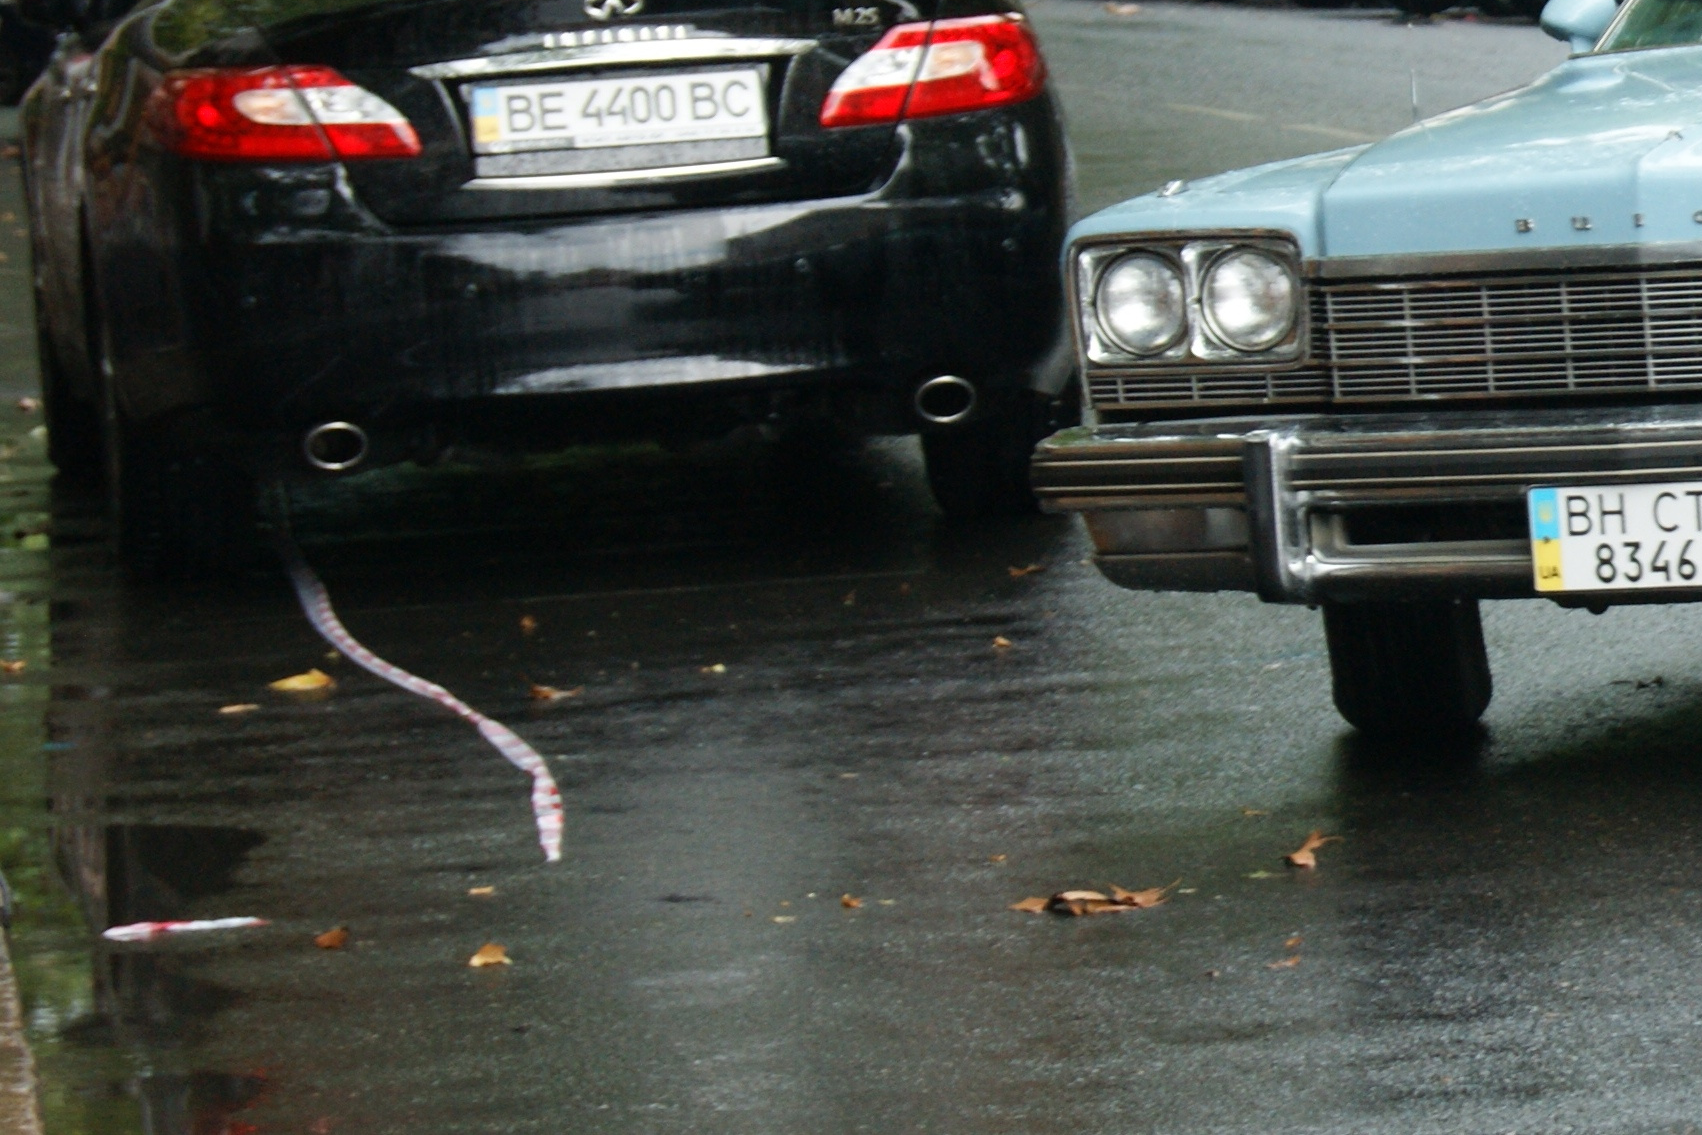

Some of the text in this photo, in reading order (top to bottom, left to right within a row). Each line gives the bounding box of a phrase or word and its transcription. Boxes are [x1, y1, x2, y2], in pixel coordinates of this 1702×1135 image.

[506, 79, 751, 133] BE 4400 BC
[1566, 492, 1627, 537] BH
[1595, 538, 1698, 584] 8346
